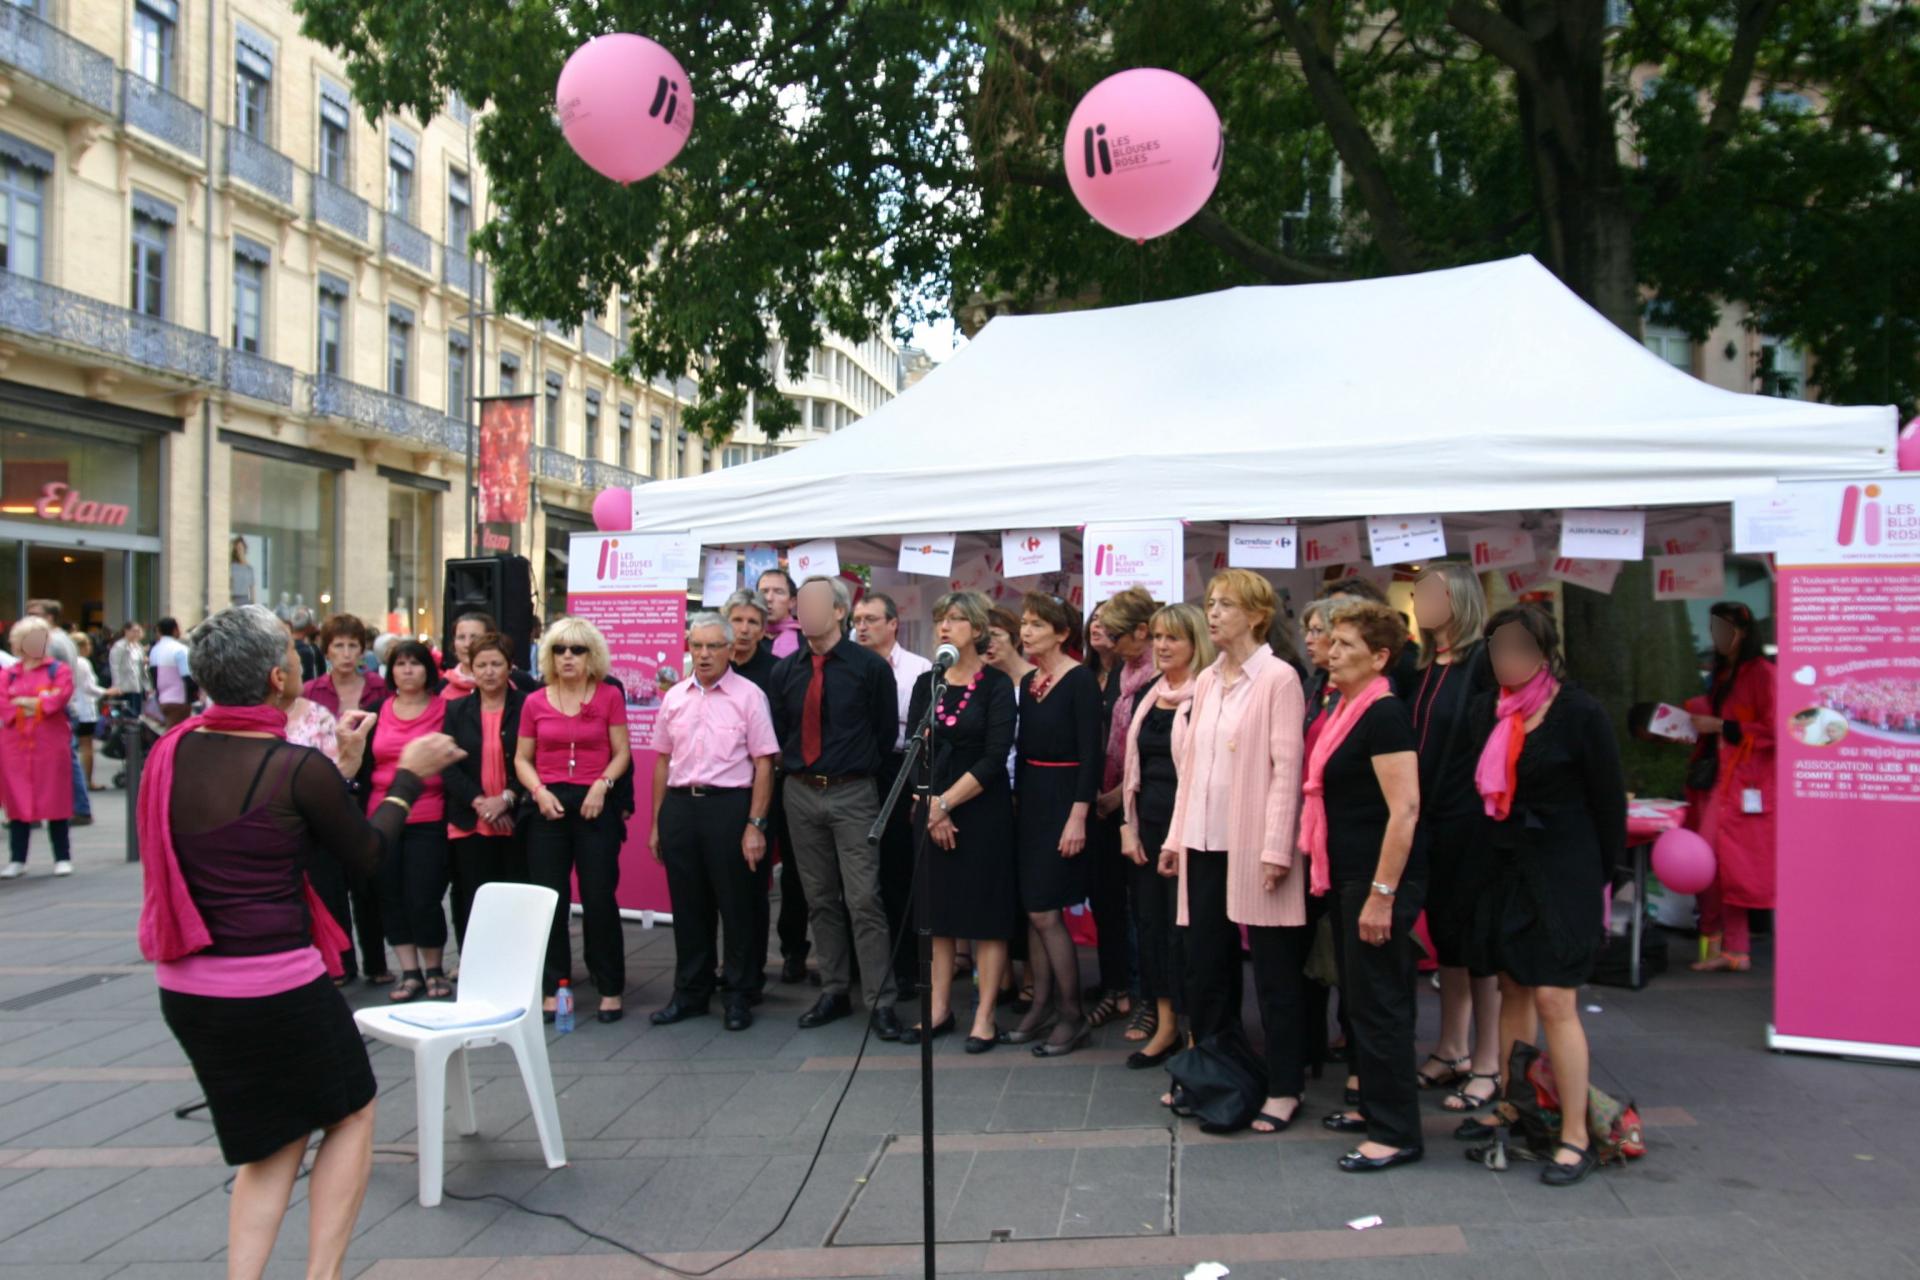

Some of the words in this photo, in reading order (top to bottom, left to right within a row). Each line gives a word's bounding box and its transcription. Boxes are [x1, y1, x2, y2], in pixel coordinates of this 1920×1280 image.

[1111, 135, 1130, 148] LES
[1112, 140, 1161, 158] BLOUSES
[1114, 154, 1148, 168] ROSES
[36, 481, 130, 526] Etam
[1887, 504, 1916, 515] LES
[1887, 517, 1920, 527] BLO
[1887, 529, 1920, 540] ROS
[620, 552, 634, 560] LES
[620, 560, 653, 568] BLOUSES
[620, 568, 643, 576] ROSES
[1796, 760, 1873, 771] ASSOCIATION
[1879, 762, 1903, 772] LES
